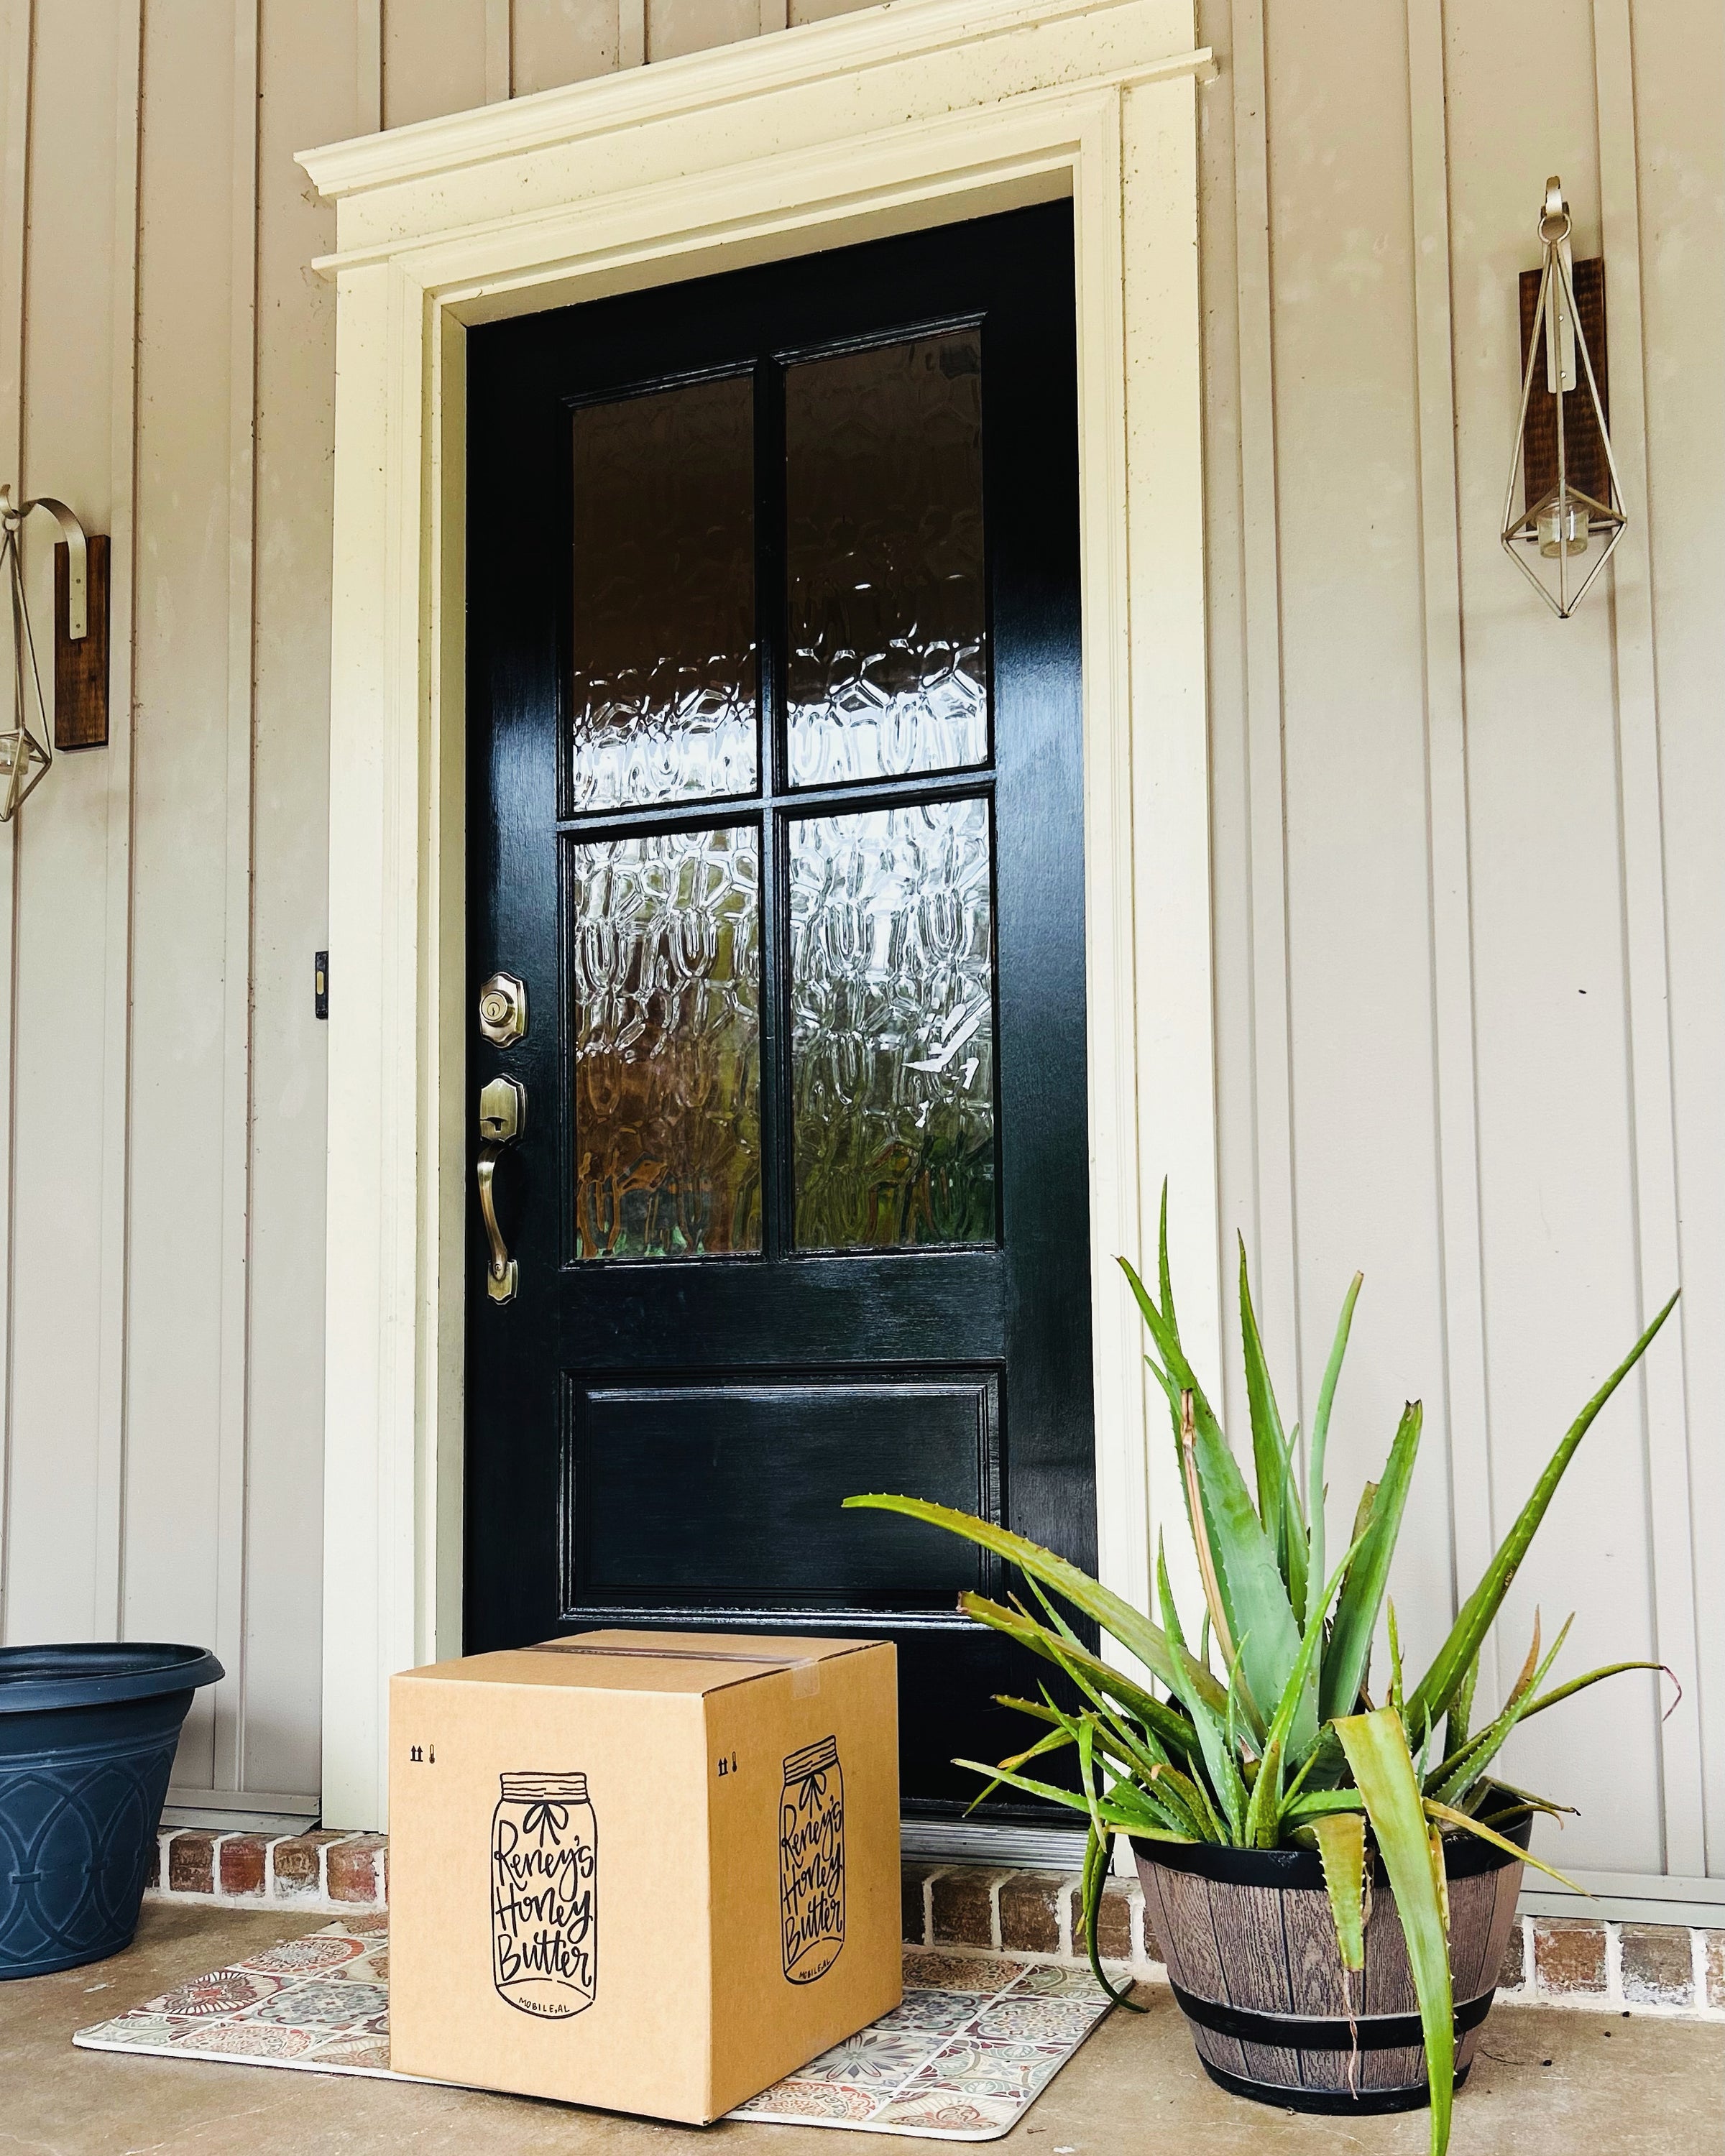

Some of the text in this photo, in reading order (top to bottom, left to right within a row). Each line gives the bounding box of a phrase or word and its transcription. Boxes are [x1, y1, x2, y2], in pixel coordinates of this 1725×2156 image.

[494, 1819, 594, 1902] Reney's
[781, 1795, 842, 1871] Reney's
[495, 1882, 593, 1944] Honey
[783, 1843, 843, 1917] Honey
[497, 1930, 592, 1988] Butter
[785, 1894, 842, 1965] Butter
